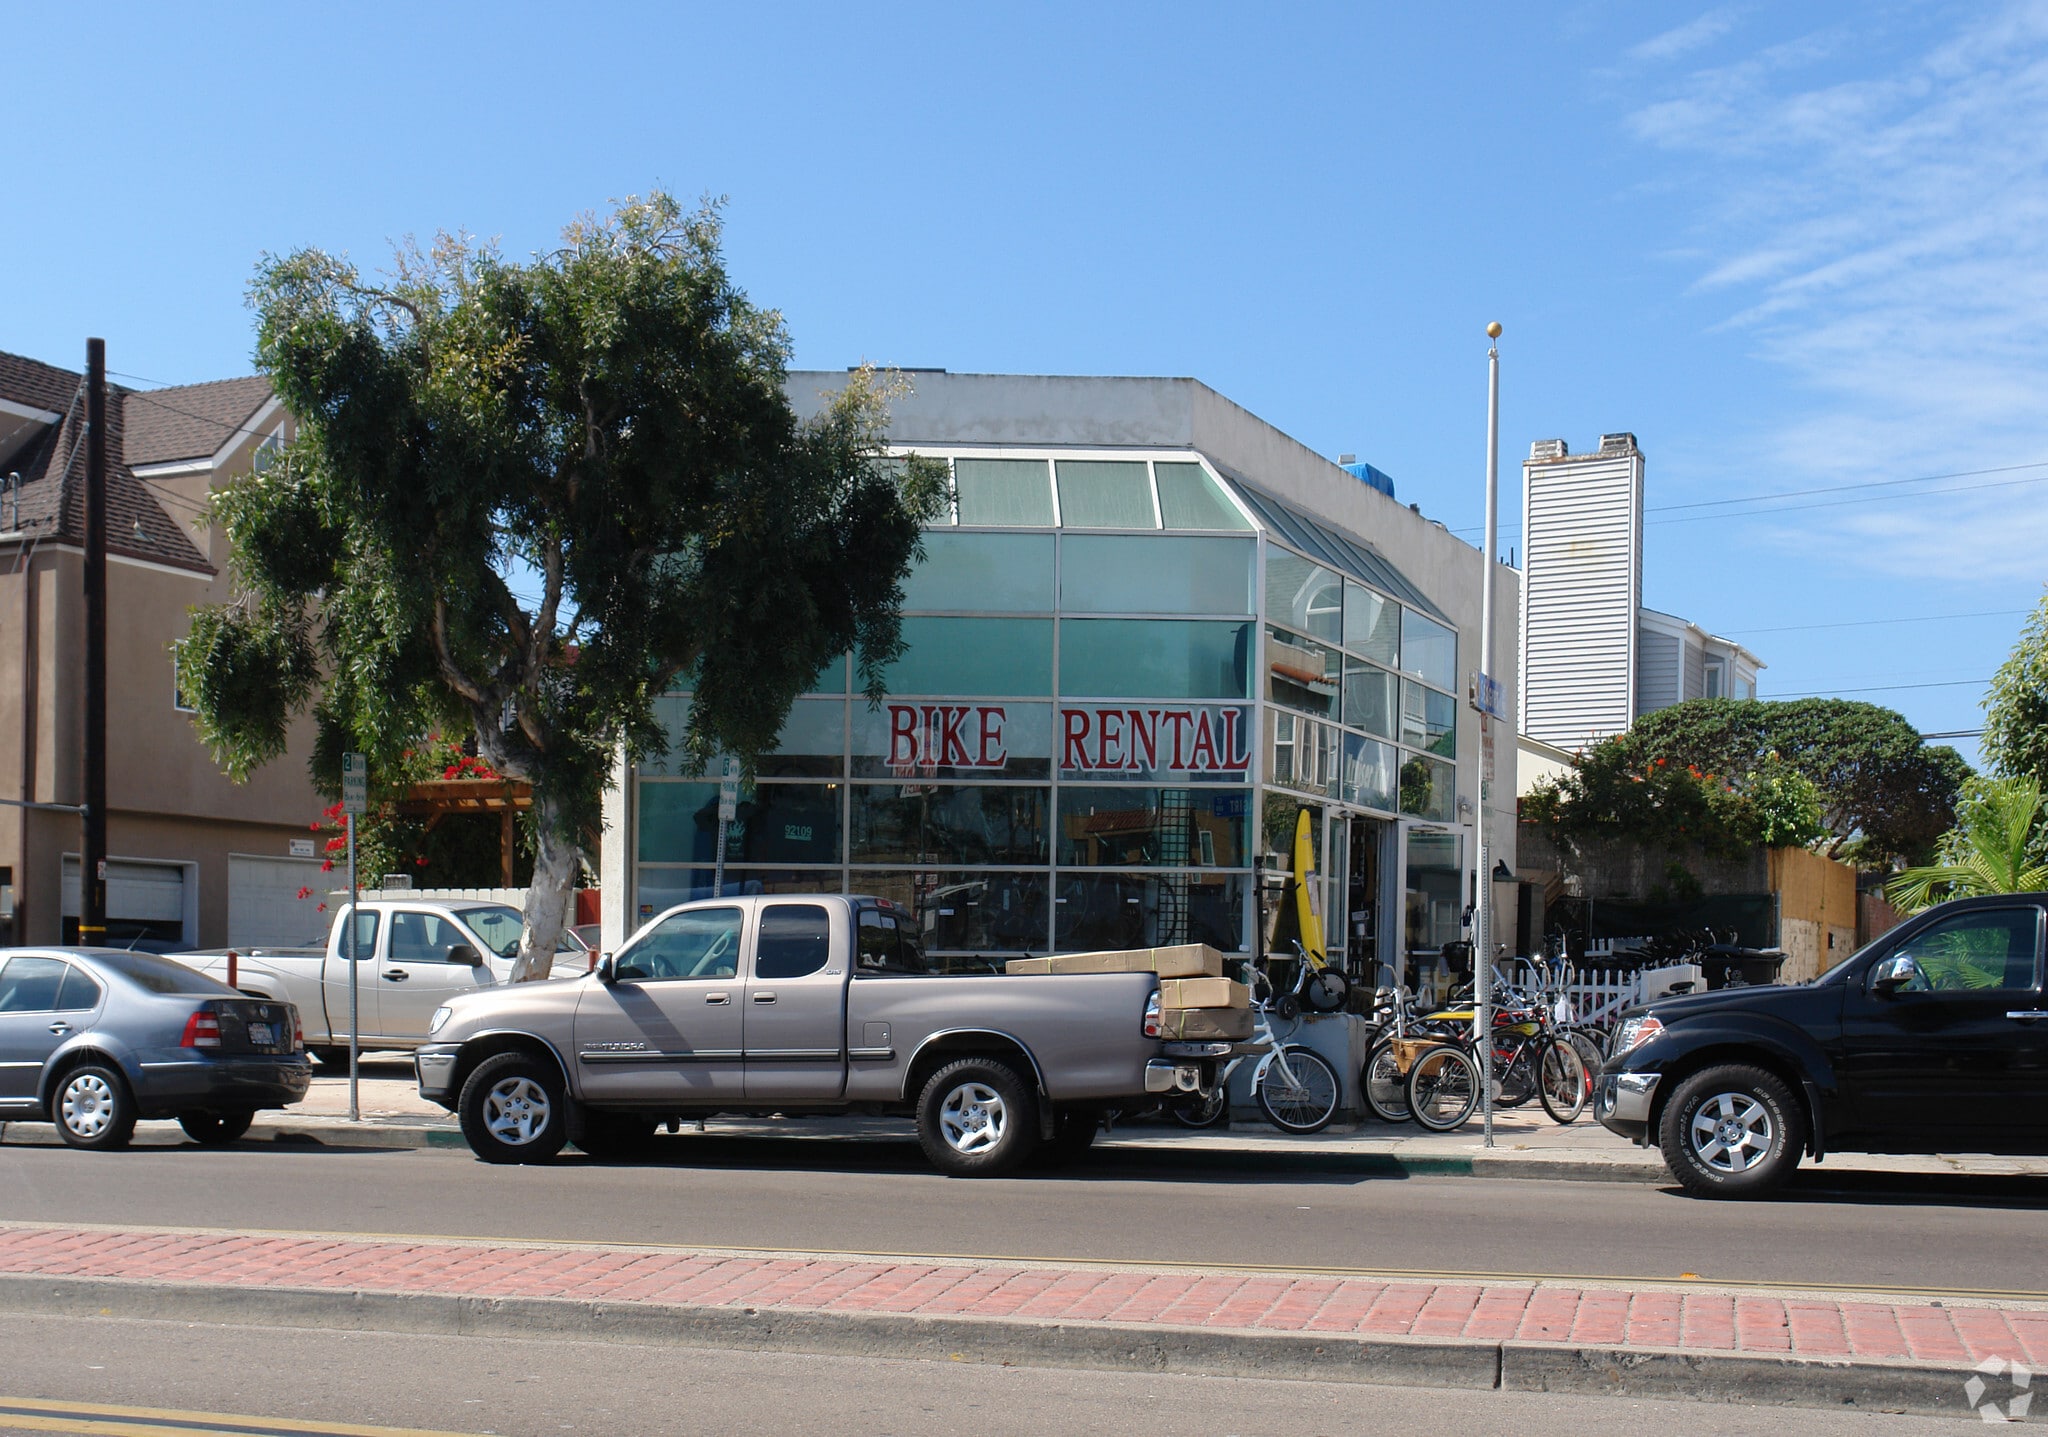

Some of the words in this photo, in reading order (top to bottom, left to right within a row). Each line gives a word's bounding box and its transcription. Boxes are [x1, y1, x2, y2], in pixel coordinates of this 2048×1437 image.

[885, 705, 1008, 768] BIKE
[1060, 708, 1252, 771] RENTAL
[344, 776, 366, 787] PARKING
[784, 824, 812, 837] 92109
